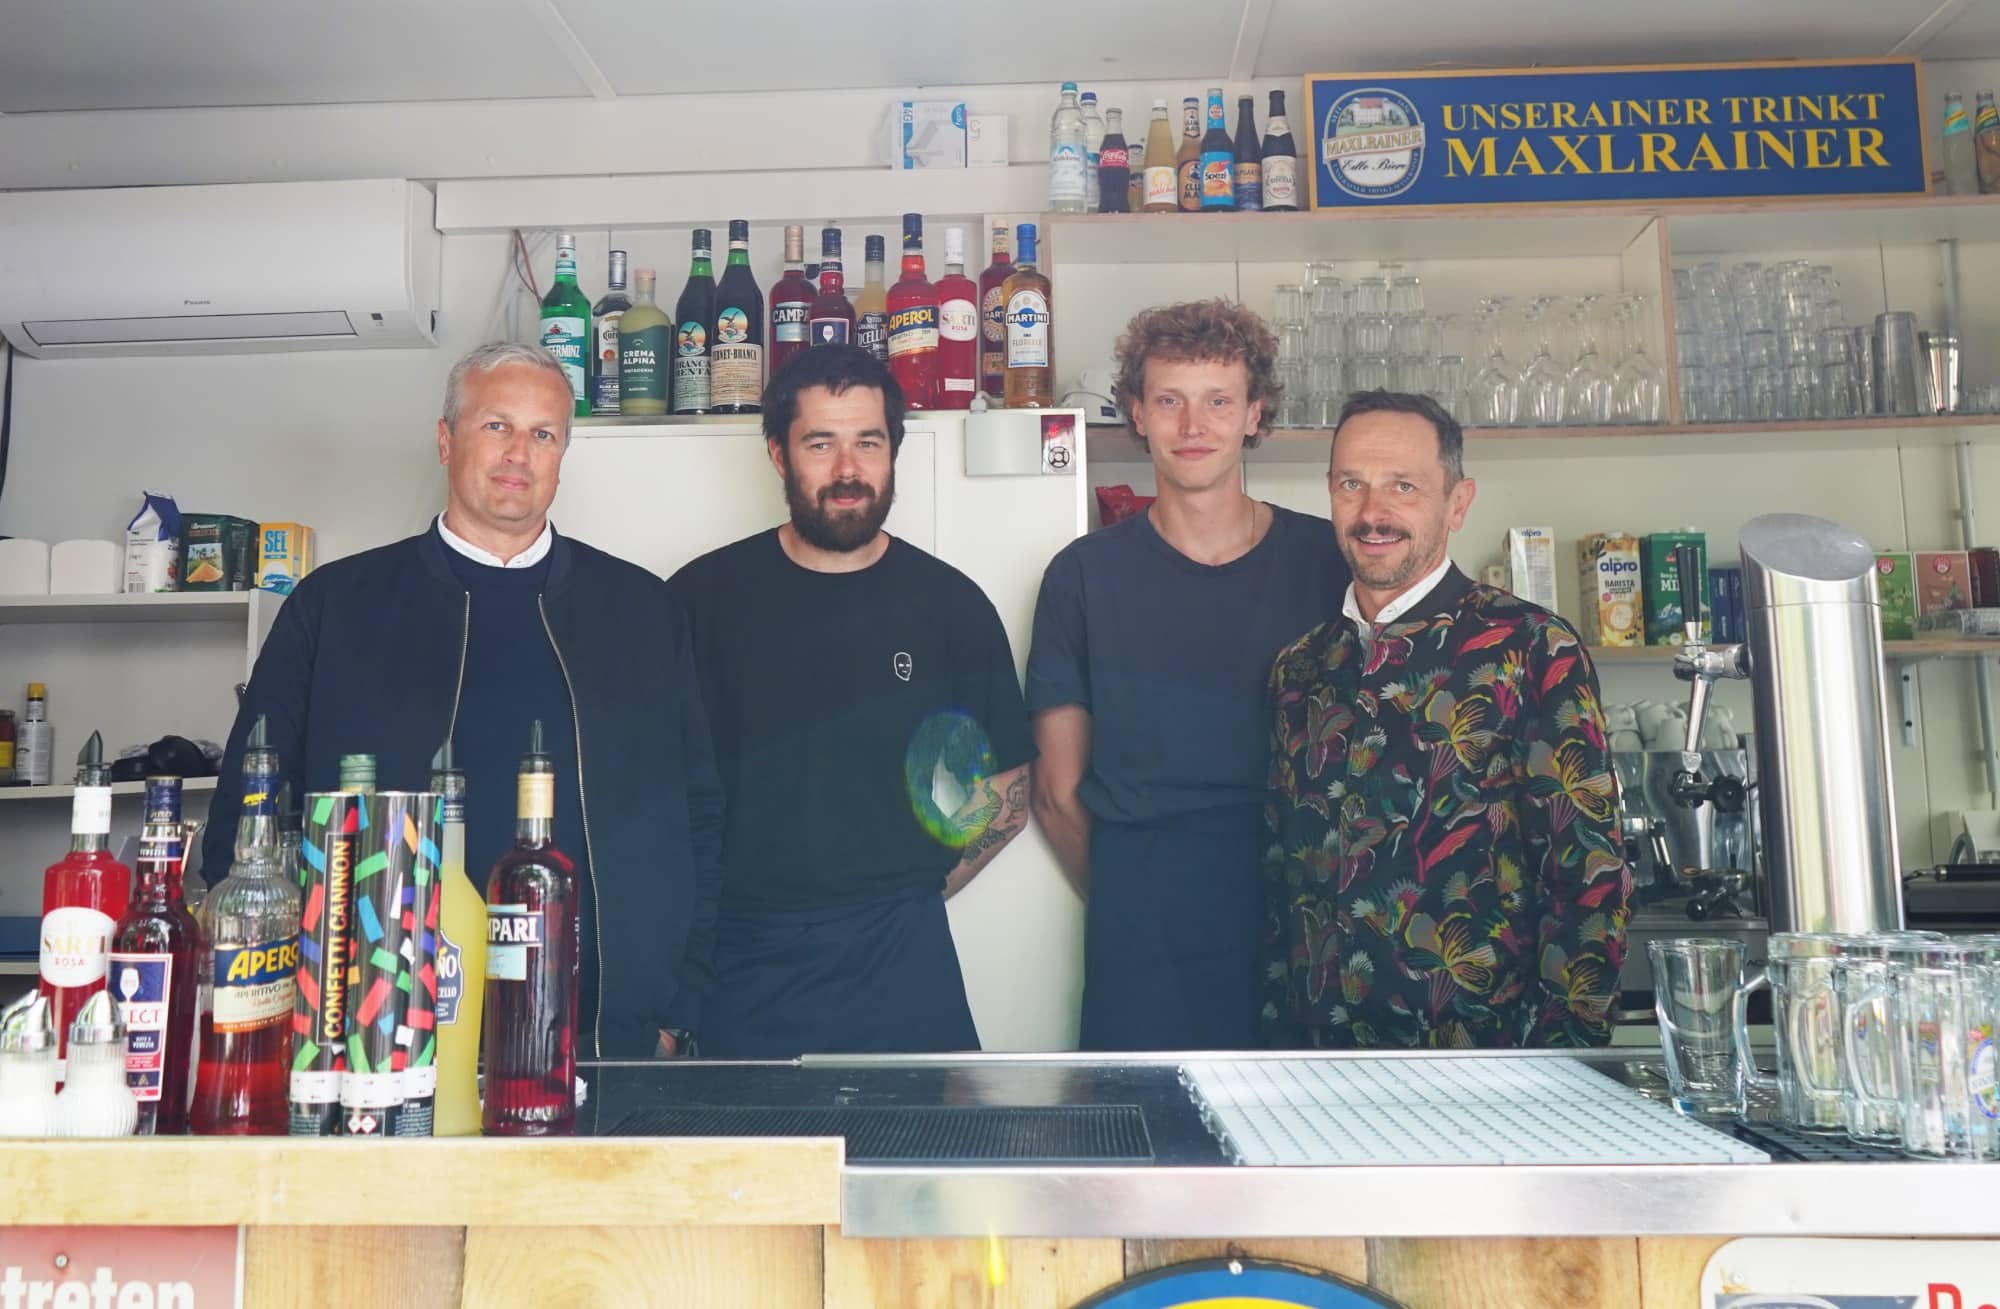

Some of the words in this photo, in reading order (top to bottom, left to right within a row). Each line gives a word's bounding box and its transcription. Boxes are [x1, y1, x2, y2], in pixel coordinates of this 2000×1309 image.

[1442, 98, 1712, 131] UNSERAINER
[1722, 93, 1884, 123] TRINKT
[1327, 130, 1422, 156] MAXLRAINER
[1442, 127, 1892, 177] MAXLRAINER
[889, 308, 934, 332] APEROL
[984, 311, 1003, 321] MART
[1007, 313, 1048, 325] MARTINI
[624, 349, 656, 358] CREMA
[1521, 529, 1542, 538] alpro
[1600, 557, 1638, 576] alpro
[1604, 580, 1635, 588] BARISTA
[328, 840, 351, 932] CANNON
[489, 916, 540, 943] PARI
[42, 935, 106, 955] SARTI
[53, 958, 86, 967] ROSA
[227, 941, 299, 982] APERO
[323, 938, 347, 1039] CONFETTI
